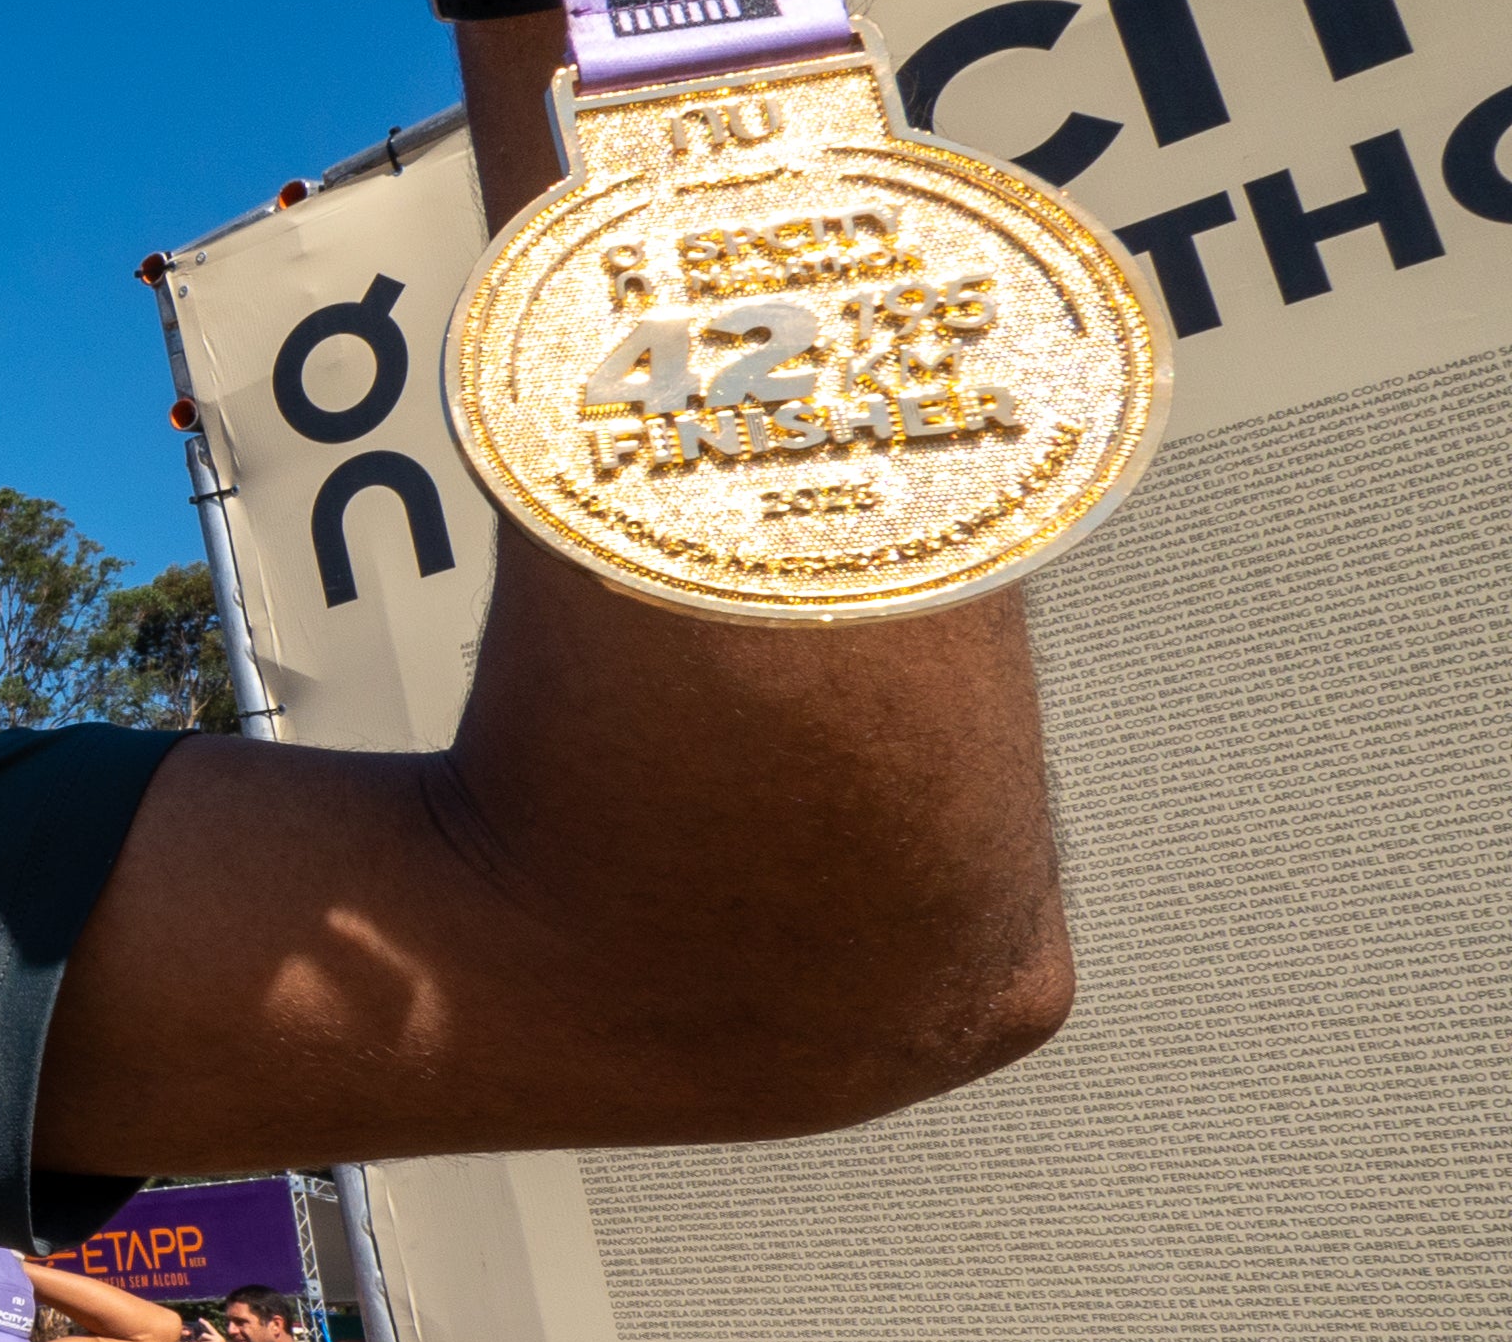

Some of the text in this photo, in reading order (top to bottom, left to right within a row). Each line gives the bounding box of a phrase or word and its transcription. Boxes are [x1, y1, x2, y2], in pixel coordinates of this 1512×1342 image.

[679, 205, 902, 259] SPCITY
[1351, 376, 1404, 399] COUTO
[593, 386, 1022, 470] FINISHER
[1266, 1191, 1315, 1202] FLAVIO
[1320, 1188, 1377, 1200] TOLEDO
[1380, 1185, 1432, 1197] FLAVIO
[1266, 1198, 1461, 1215] FRANCISCO PARENTE NETO
[1352, 1253, 1423, 1265] GERALDO
[1365, 1267, 1432, 1278] GIOVANE
[1436, 1265, 1496, 1276] BATISTA
[129, 1275, 149, 1288] SEM
[1336, 1280, 1454, 1291] ALVES COSTA
[1304, 1293, 1485, 1306] FIGUEIREDO RODRIGUES
[1283, 1320, 1502, 1333] GUILHERME RUBELLO LIMA
